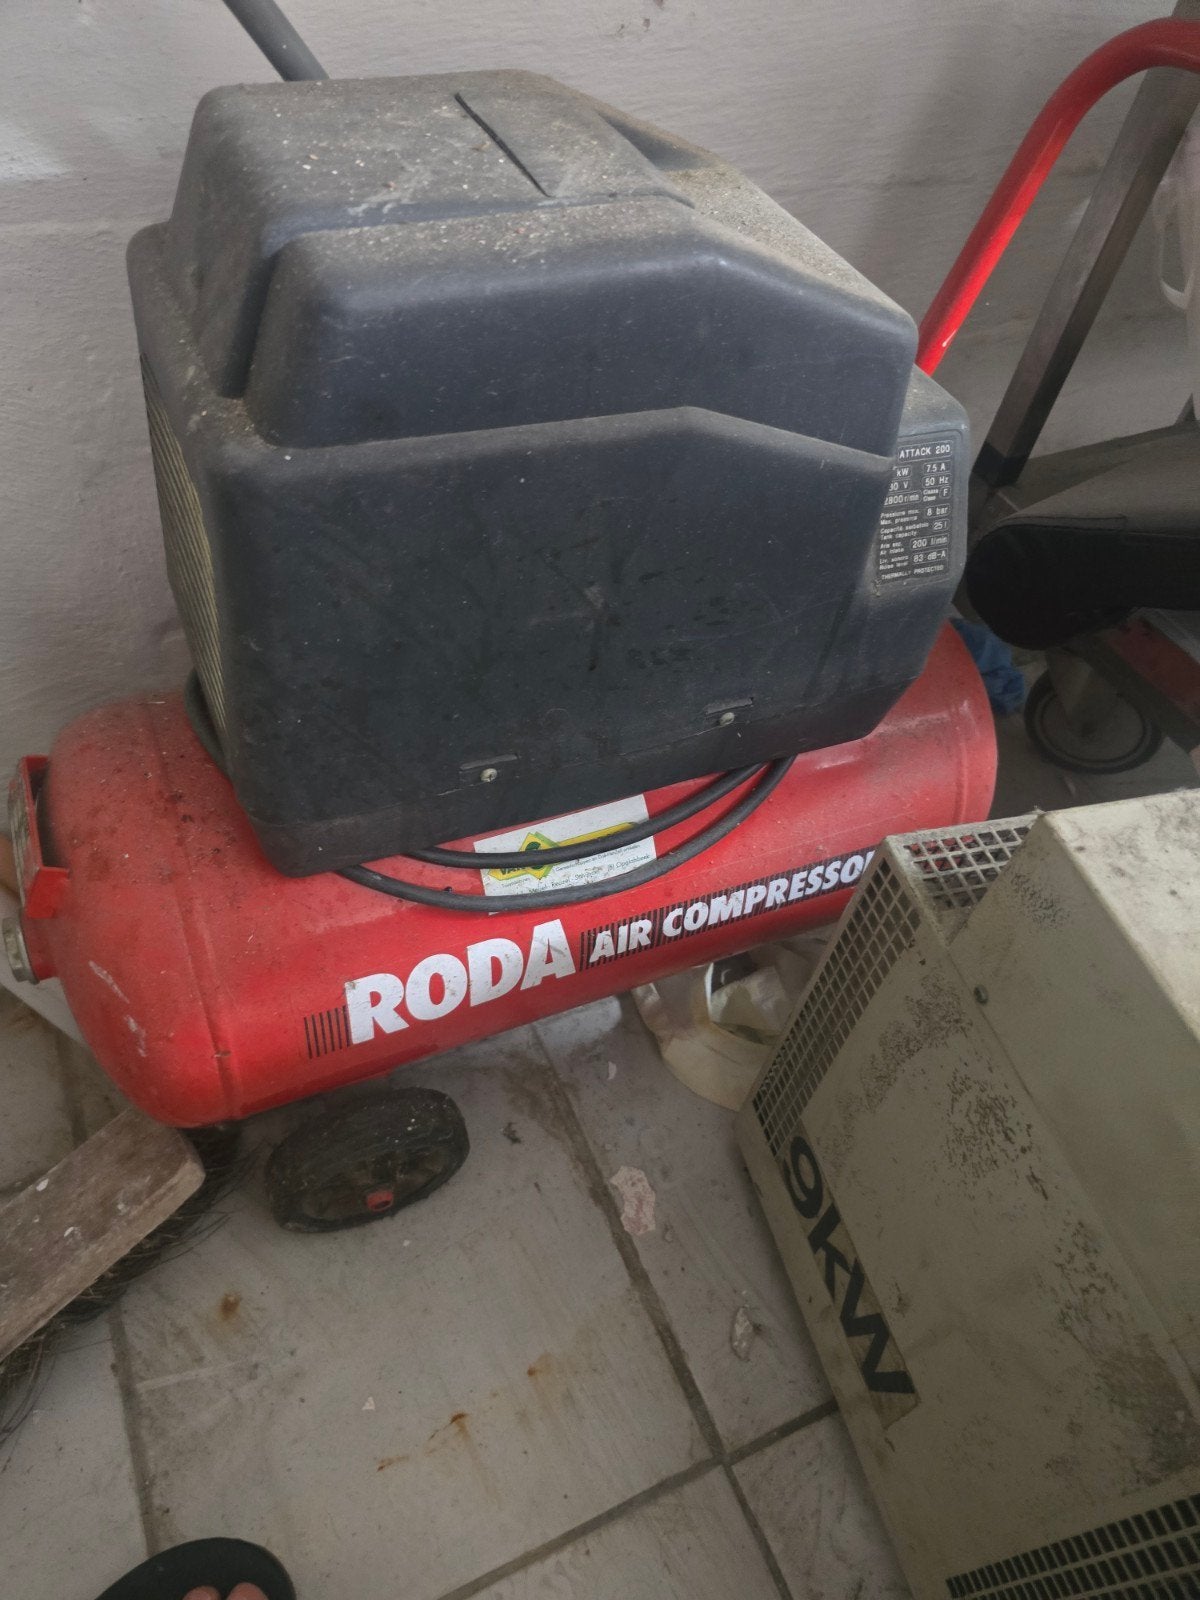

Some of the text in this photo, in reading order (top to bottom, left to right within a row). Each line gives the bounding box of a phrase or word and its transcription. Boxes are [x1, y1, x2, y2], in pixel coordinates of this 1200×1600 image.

[899, 444, 951, 459] ATTACK 200
[940, 463, 946, 471] A
[903, 481, 909, 489] V
[925, 476, 949, 487] 50 Hz
[943, 488, 948, 497] F
[926, 507, 948, 516] 8 bar
[933, 522, 943, 530] 25
[912, 539, 928, 549] 200
[913, 553, 924, 562] 83
[881, 564, 945, 580] THERMALLY PROTECTED
[345, 919, 577, 1044] RODA
[589, 919, 652, 963] AIR
